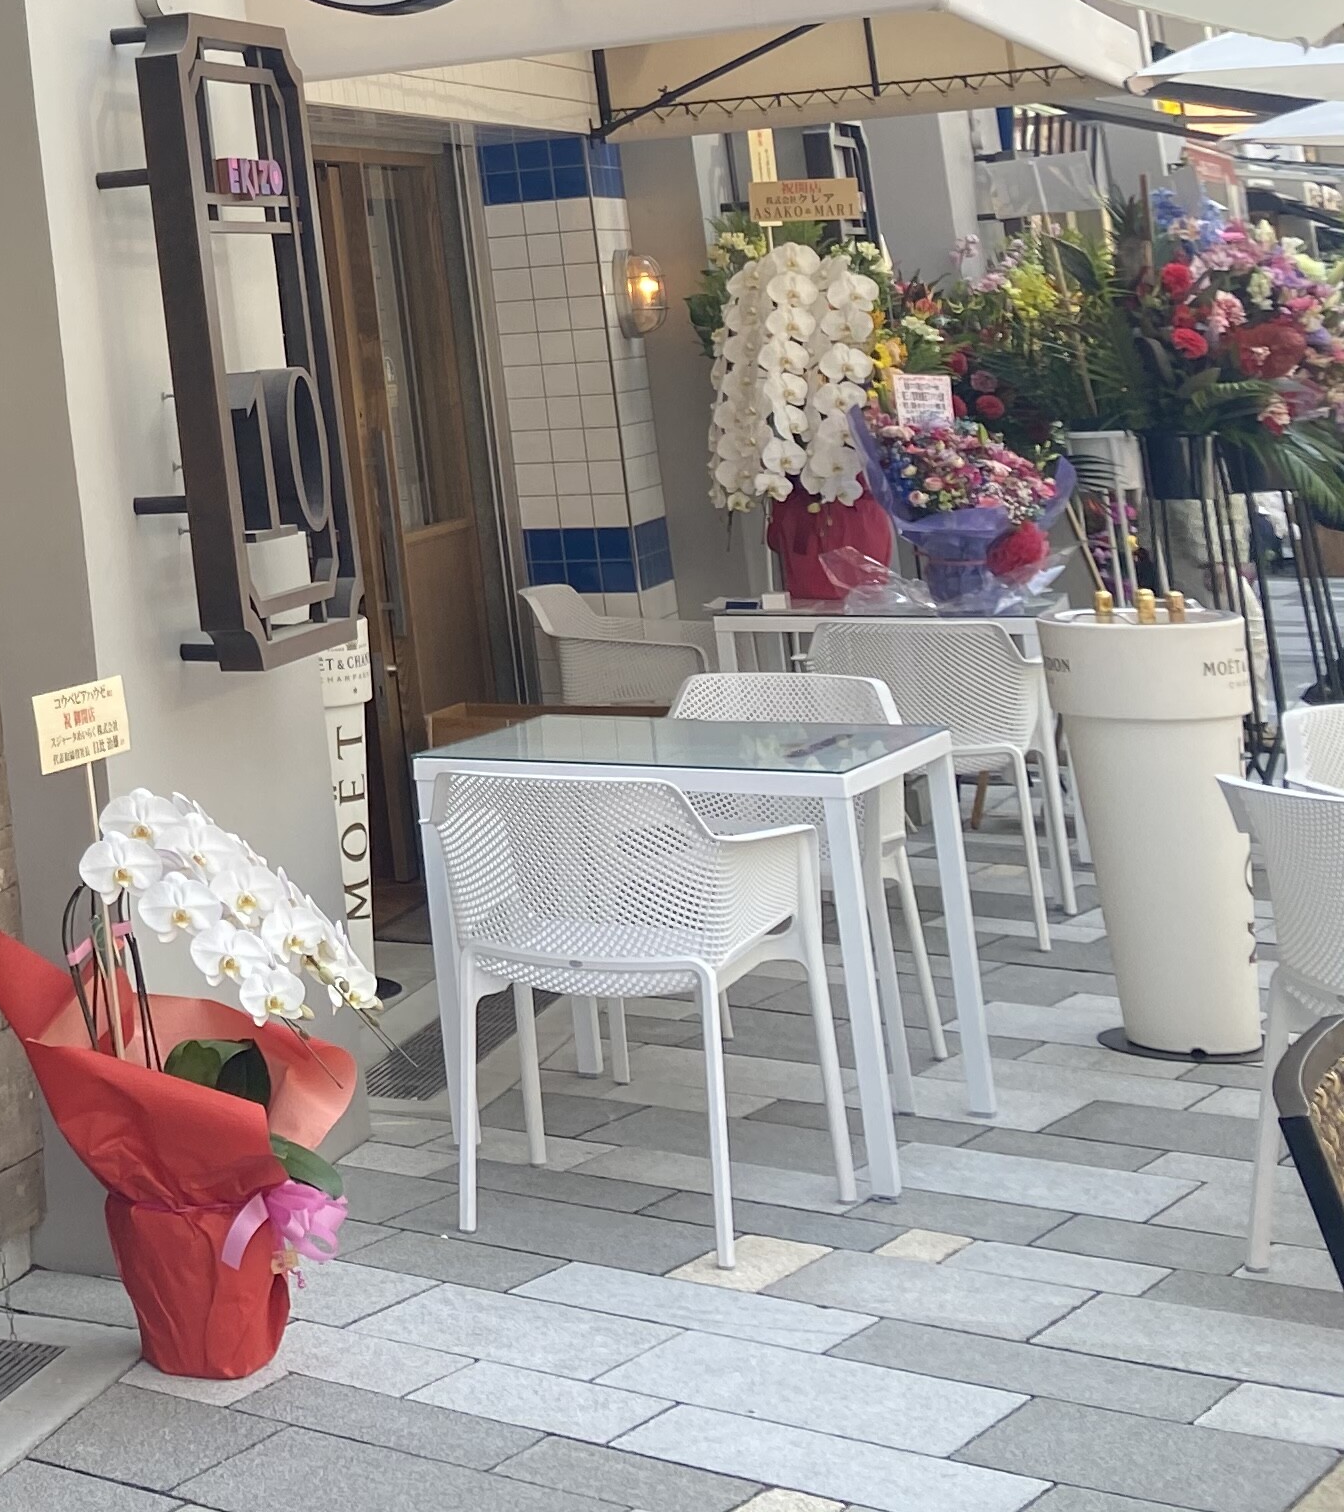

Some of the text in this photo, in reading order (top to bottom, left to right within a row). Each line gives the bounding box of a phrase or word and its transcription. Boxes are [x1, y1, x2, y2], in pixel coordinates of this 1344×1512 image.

[227, 157, 284, 201] EKIZO
[753, 202, 855, 220] ASAKO MARI
[332, 724, 371, 921] MOËT
